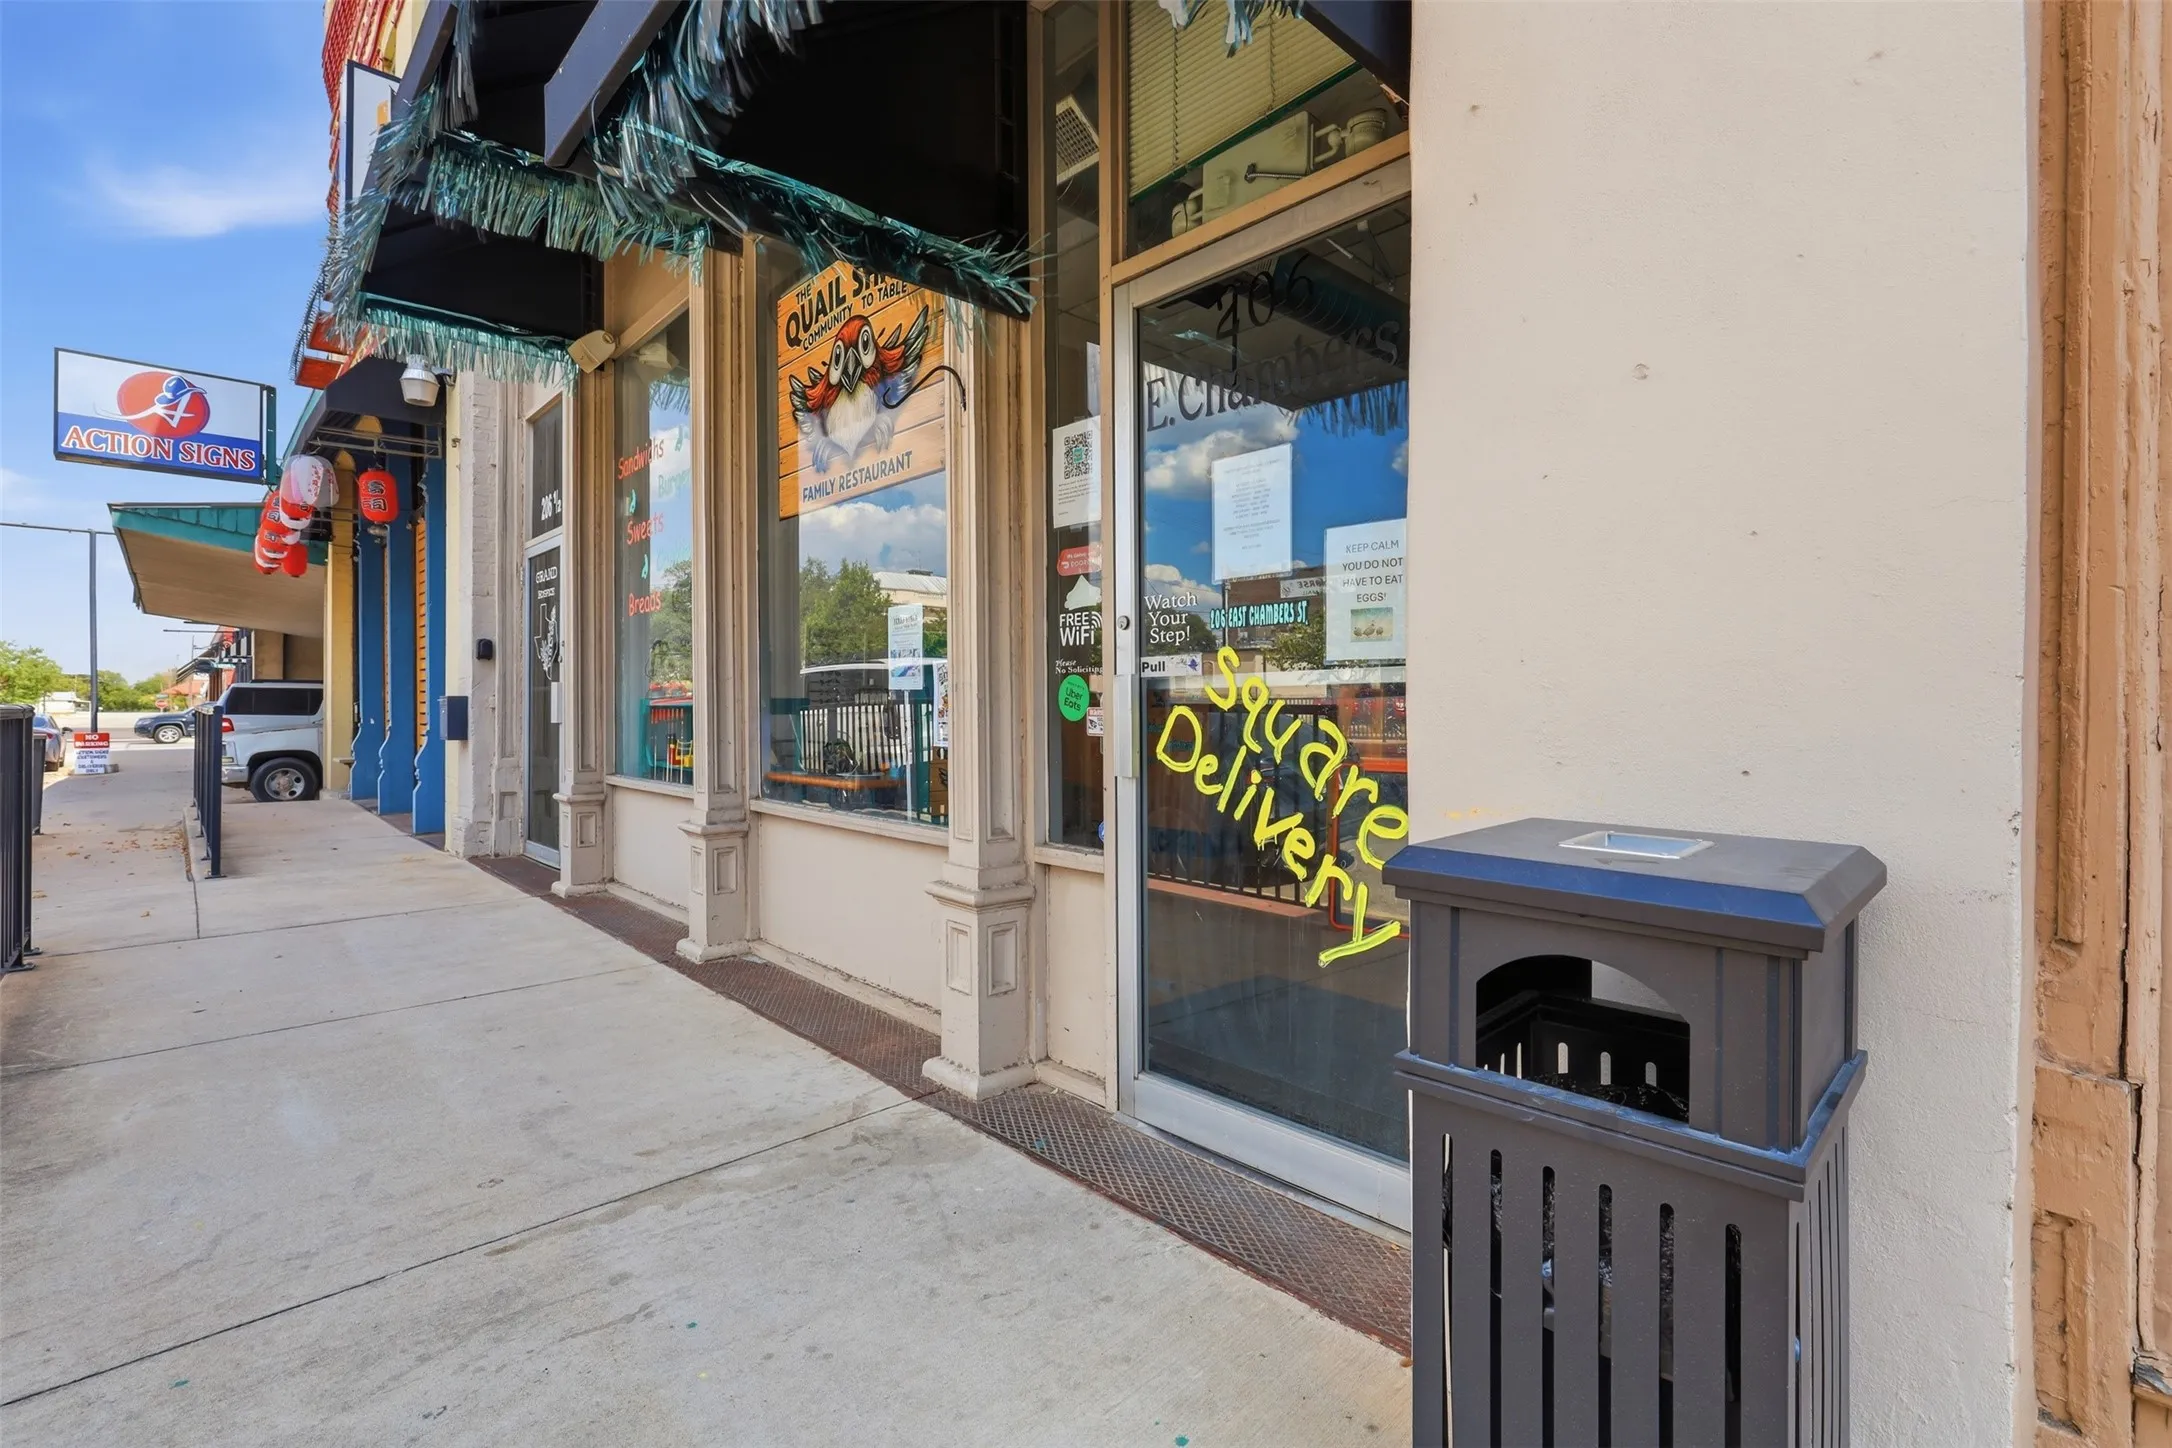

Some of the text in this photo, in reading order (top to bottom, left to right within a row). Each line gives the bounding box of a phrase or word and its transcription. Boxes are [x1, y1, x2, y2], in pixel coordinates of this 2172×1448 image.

[796, 282, 812, 305] THE
[786, 275, 847, 348] QUAIL
[803, 281, 908, 351] COMMUNITY TO TABLE
[61, 424, 256, 471] ACTION SIGNS
[802, 450, 913, 503] FAMILY RESTAURANT
[627, 511, 665, 546] Sweets
[1345, 540, 1400, 554] KEEP CALM
[1342, 557, 1404, 572] YOU DO NOT
[535, 566, 558, 584] GRAND
[1342, 574, 1404, 588] HAVE TO EAT
[628, 590, 663, 617] Breads
[1144, 592, 1198, 610] Watch
[1356, 592, 1388, 603] EGGS!
[1060, 611, 1090, 628] FREE
[1148, 610, 1189, 627] Your
[1210, 607, 1226, 629] 206
[1228, 604, 1248, 628] EAST
[1249, 601, 1295, 626] CHAMBERS
[1060, 625, 1095, 646] WiFi
[1150, 626, 1191, 646] Step!
[1055, 665, 1066, 674] No
[1142, 661, 1166, 673] Pull
[1065, 686, 1083, 701] Uber
[1063, 697, 1082, 713] Eats
[1205, 646, 1409, 870] Square
[1156, 705, 1402, 968] Delivery
